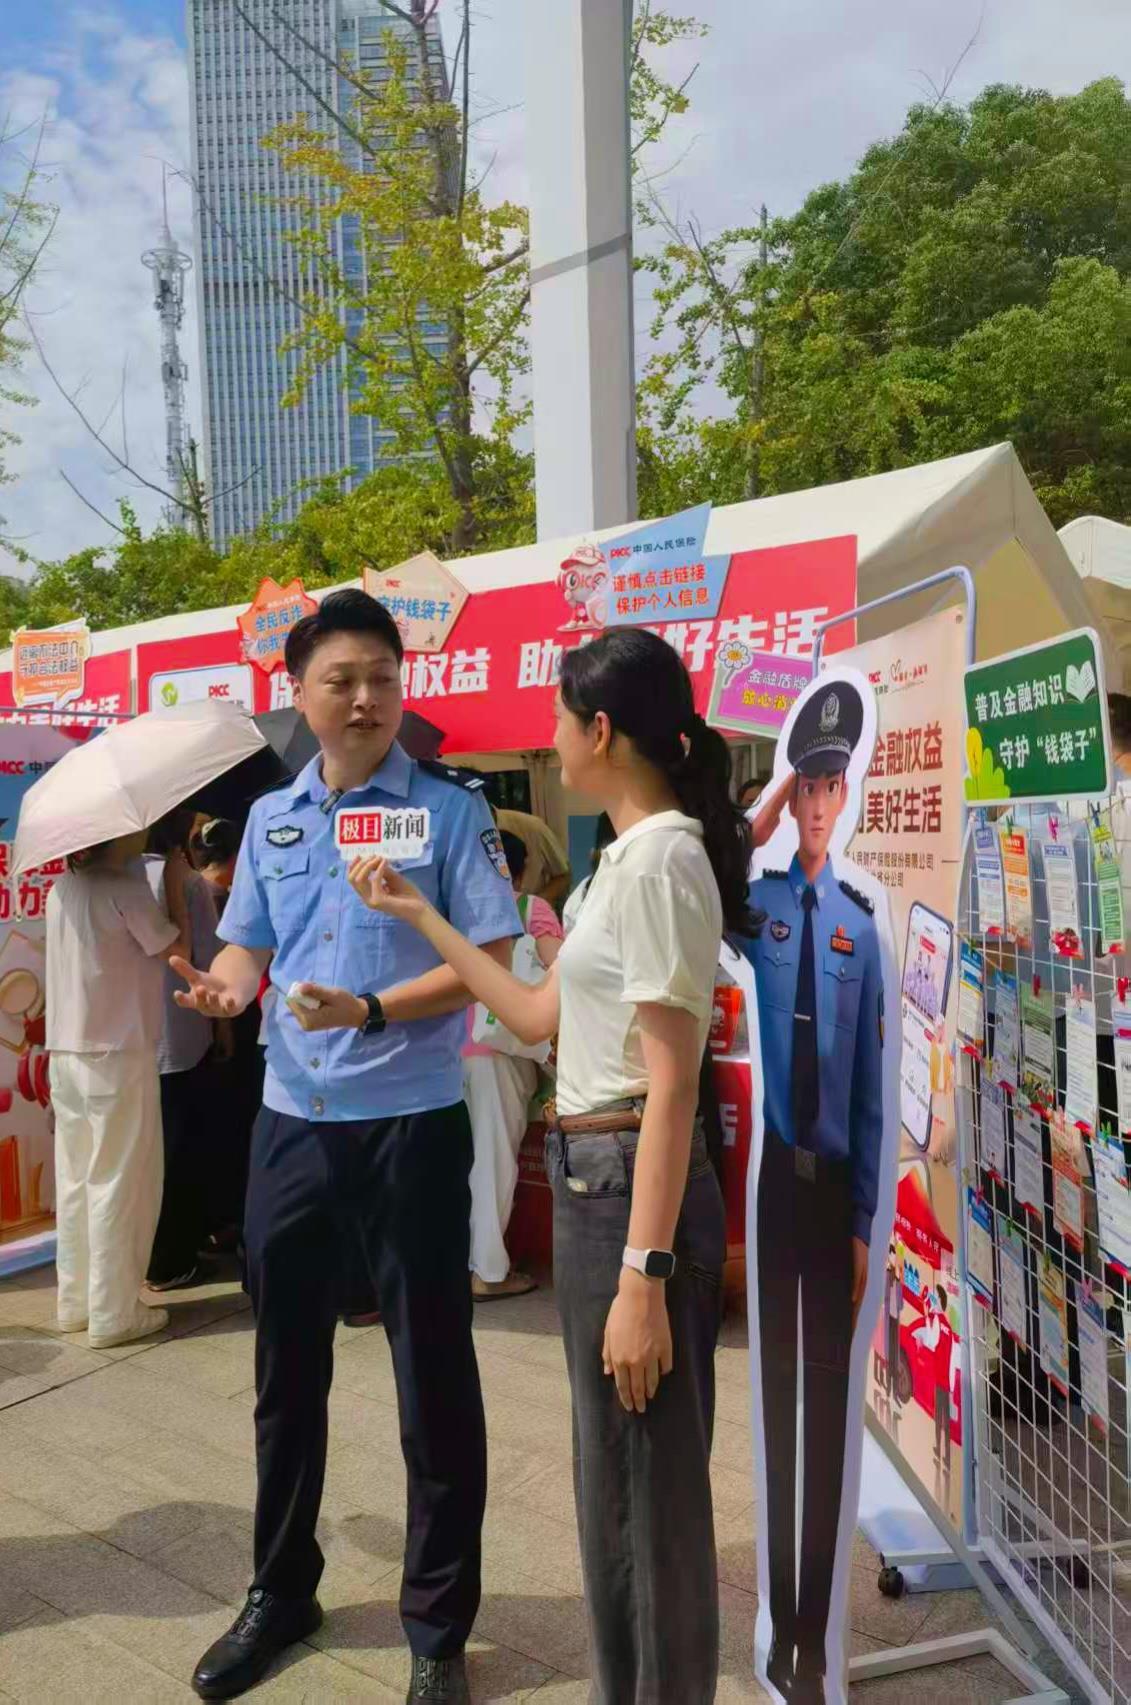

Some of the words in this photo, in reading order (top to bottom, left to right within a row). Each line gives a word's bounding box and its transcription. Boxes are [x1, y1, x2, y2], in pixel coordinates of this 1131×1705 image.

[632, 537, 697, 553] 中国人民保险
[613, 564, 706, 592] 谨慎点击链接
[616, 588, 710, 615] 保护个人信息
[208, 684, 230, 697] PICC
[975, 674, 1064, 722] 普及金融知识
[859, 785, 942, 834] 美好生活
[343, 813, 425, 841] 极目新闻
